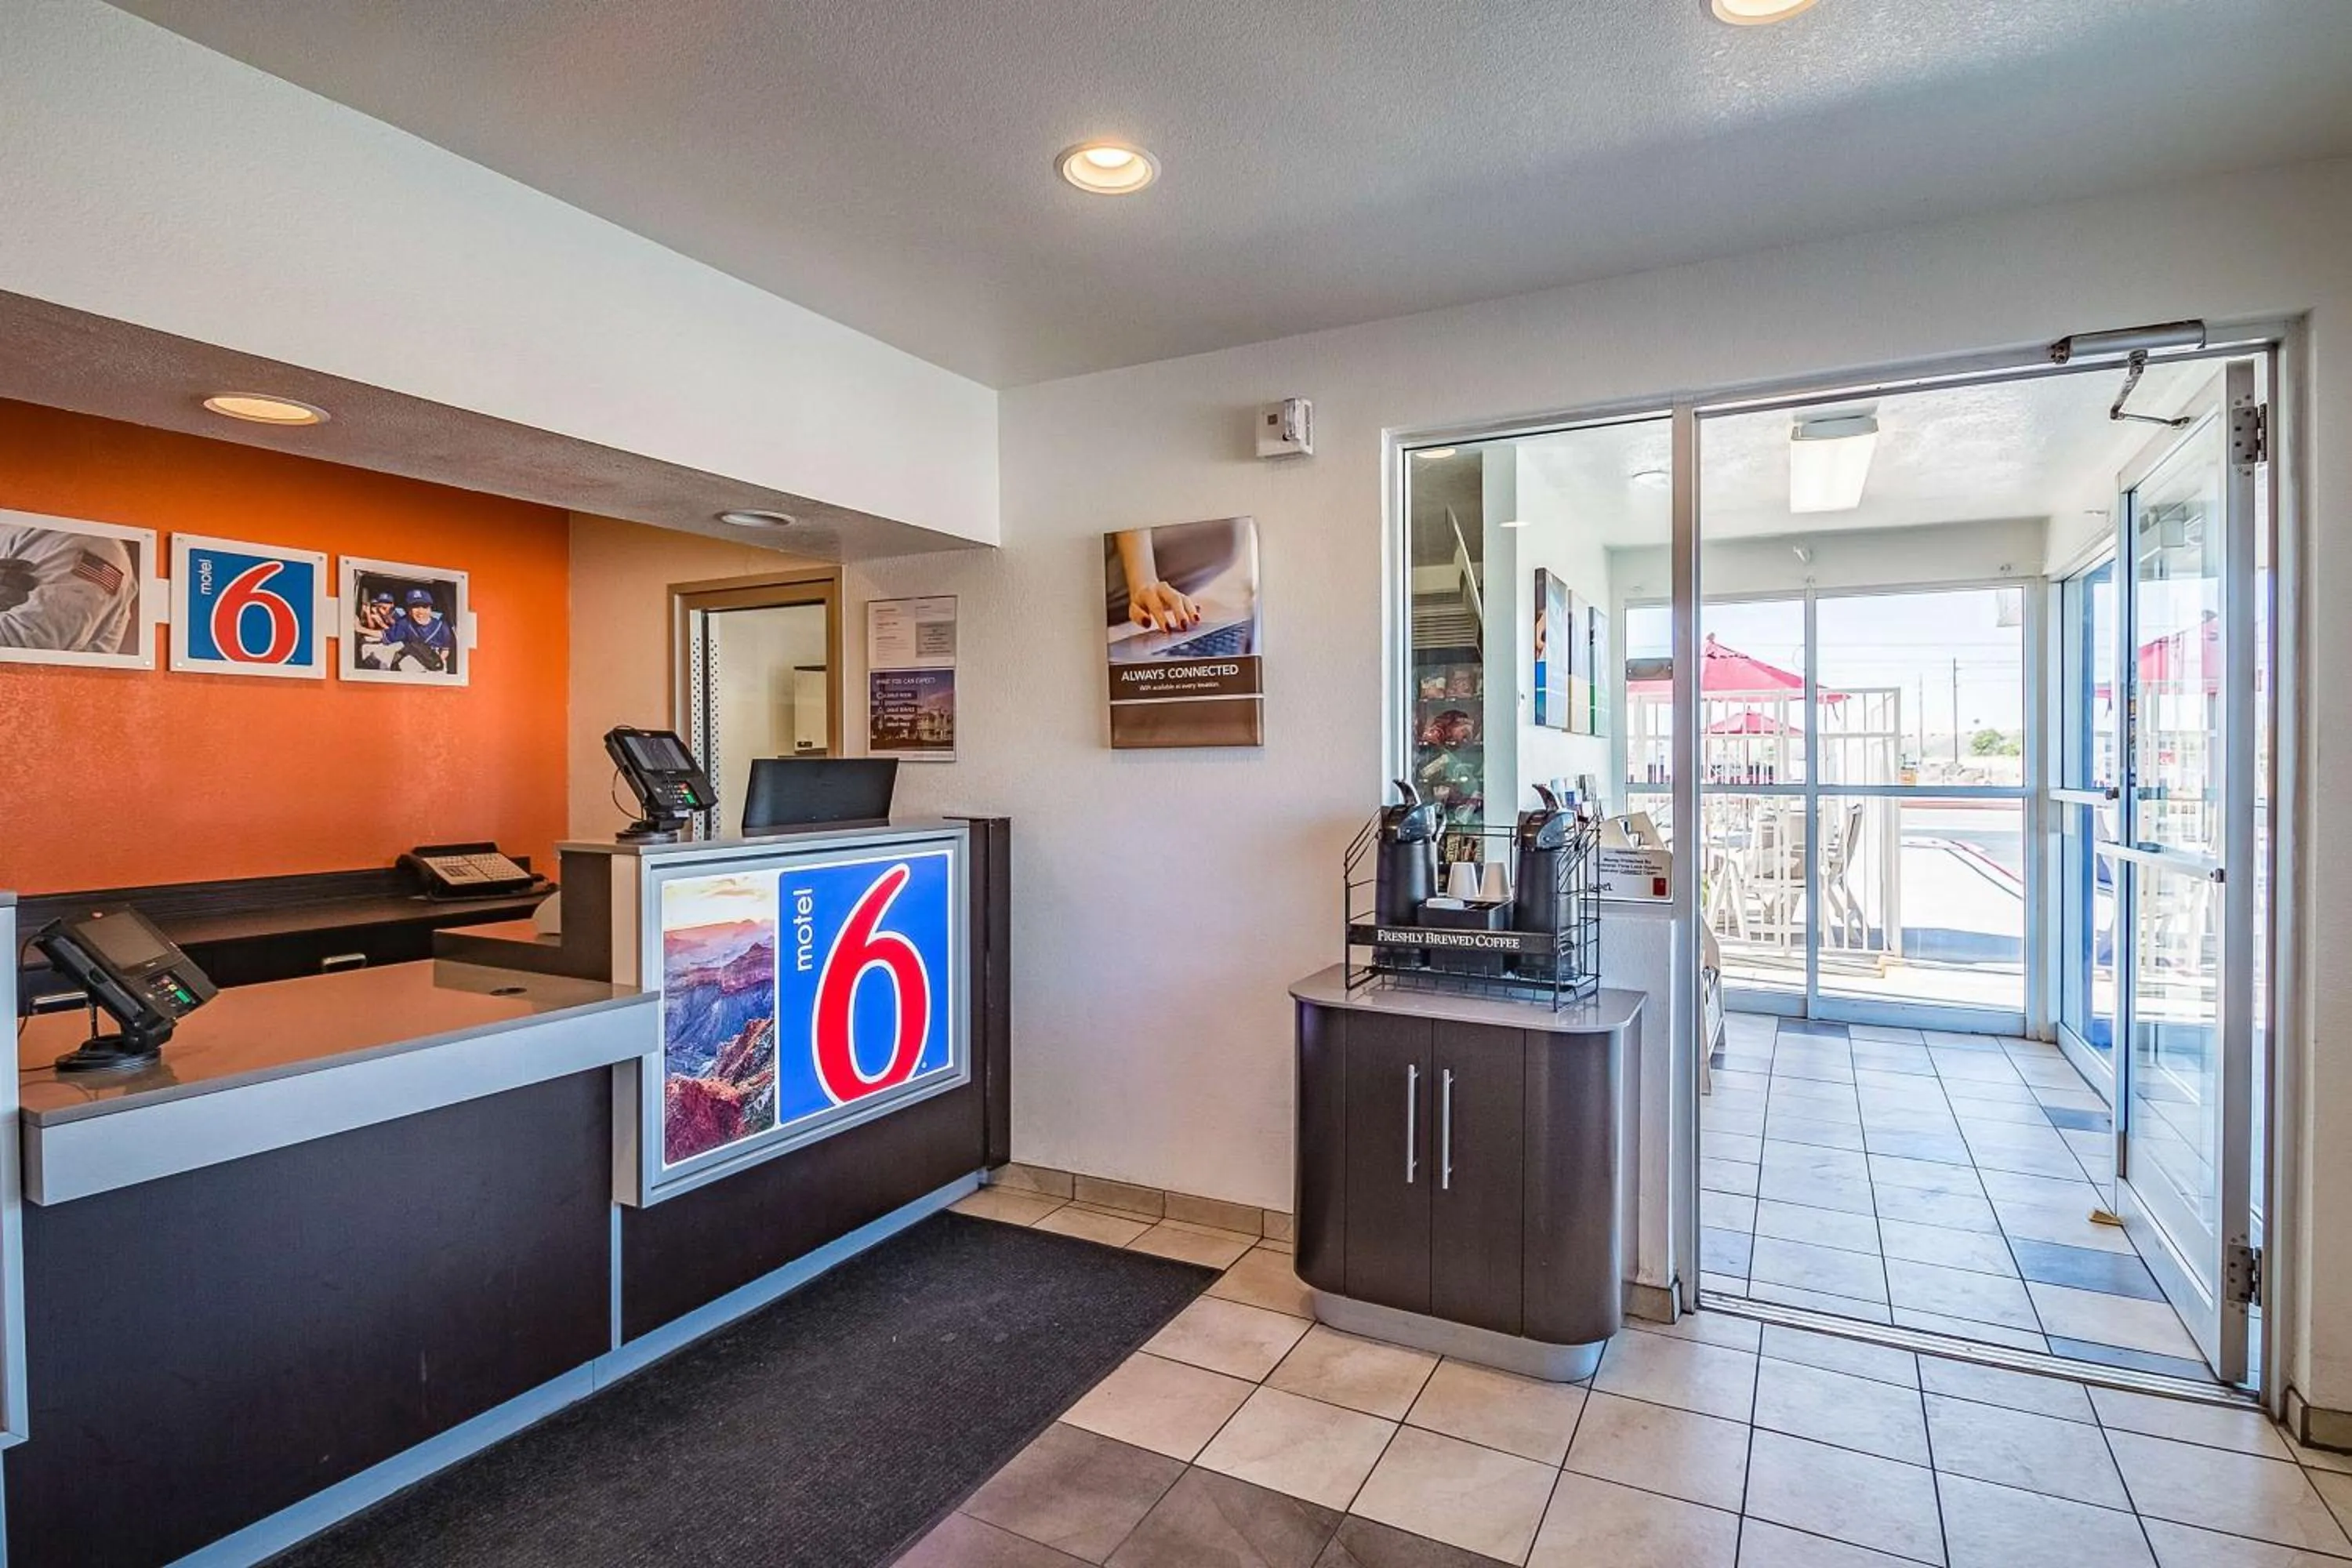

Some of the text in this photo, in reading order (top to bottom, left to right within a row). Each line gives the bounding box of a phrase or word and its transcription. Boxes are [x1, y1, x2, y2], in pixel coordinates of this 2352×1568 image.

[198, 558, 299, 665] motel 6
[1121, 664, 1239, 681] ALWAYS CONNECTED
[1377, 929, 1521, 949] FRESHLY BREWED COFFEE
[793, 862, 931, 1105] motel 6
